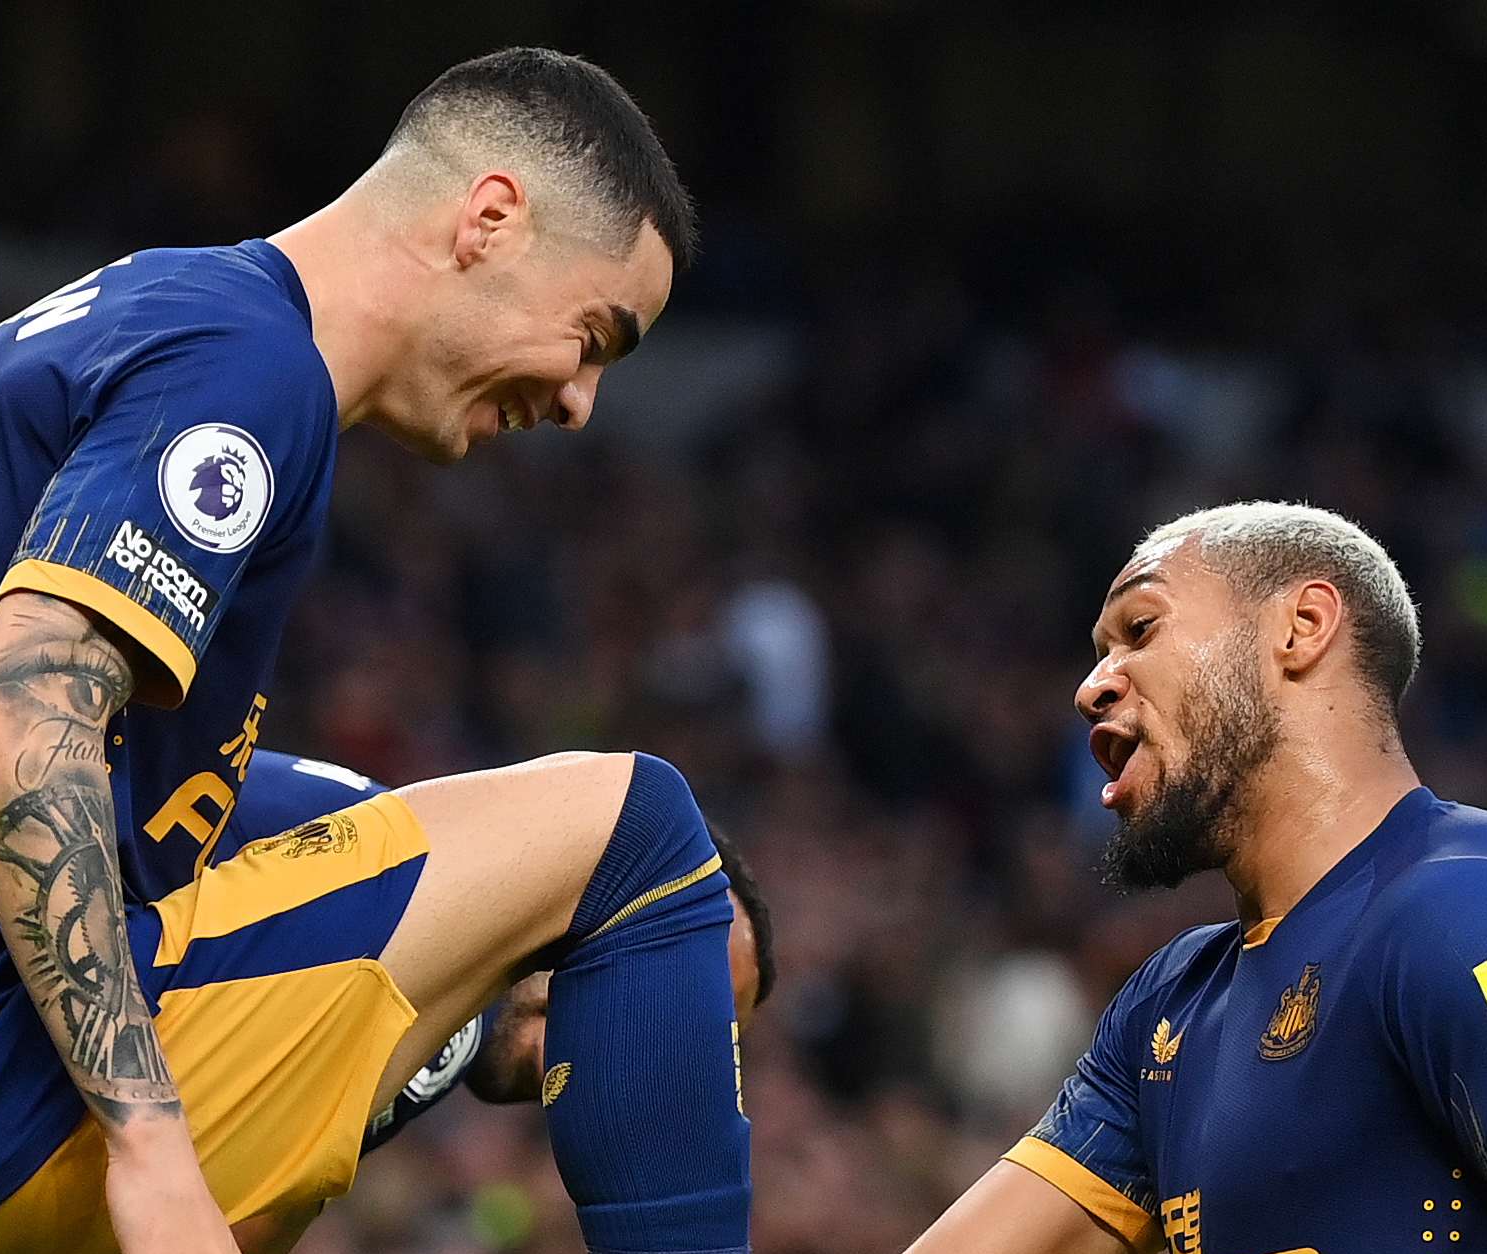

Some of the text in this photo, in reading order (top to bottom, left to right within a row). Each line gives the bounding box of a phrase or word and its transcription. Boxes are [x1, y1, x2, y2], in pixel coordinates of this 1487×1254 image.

[192, 510, 252, 537] Premier League
[113, 520, 208, 607] No room
[141, 563, 206, 632] racism
